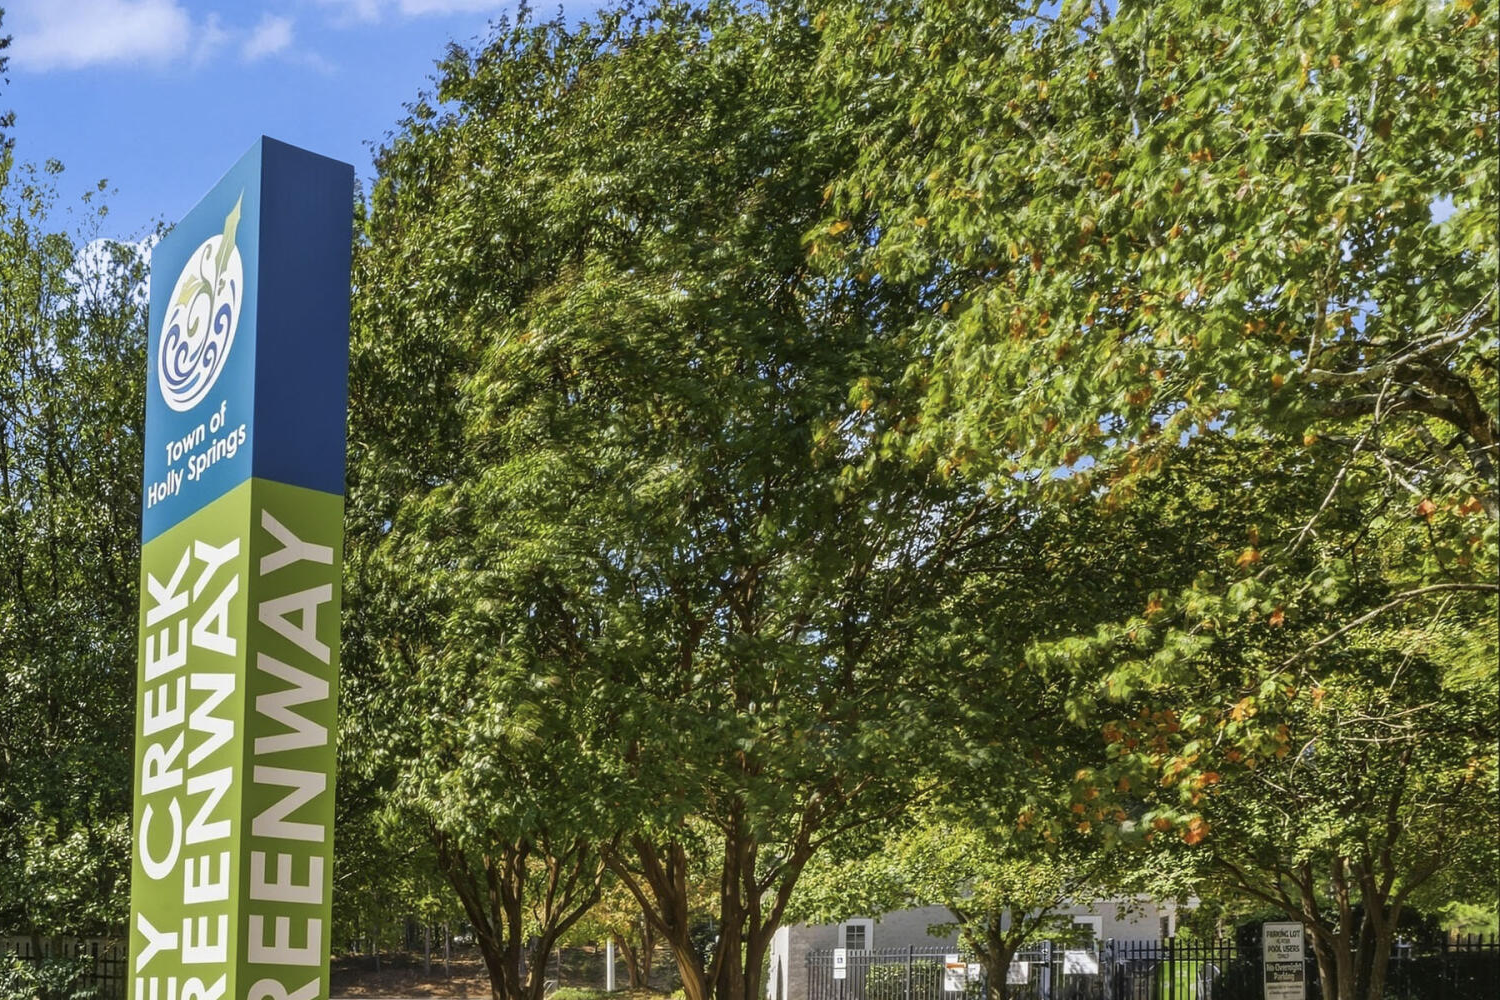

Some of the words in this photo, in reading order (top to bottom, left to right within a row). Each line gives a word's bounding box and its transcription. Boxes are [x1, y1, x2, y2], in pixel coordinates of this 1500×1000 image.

[147, 468, 184, 509] Holly
[187, 423, 246, 482] Springs
[166, 423, 205, 467] Town
[209, 400, 227, 434] of
[139, 545, 191, 880] CREEK
